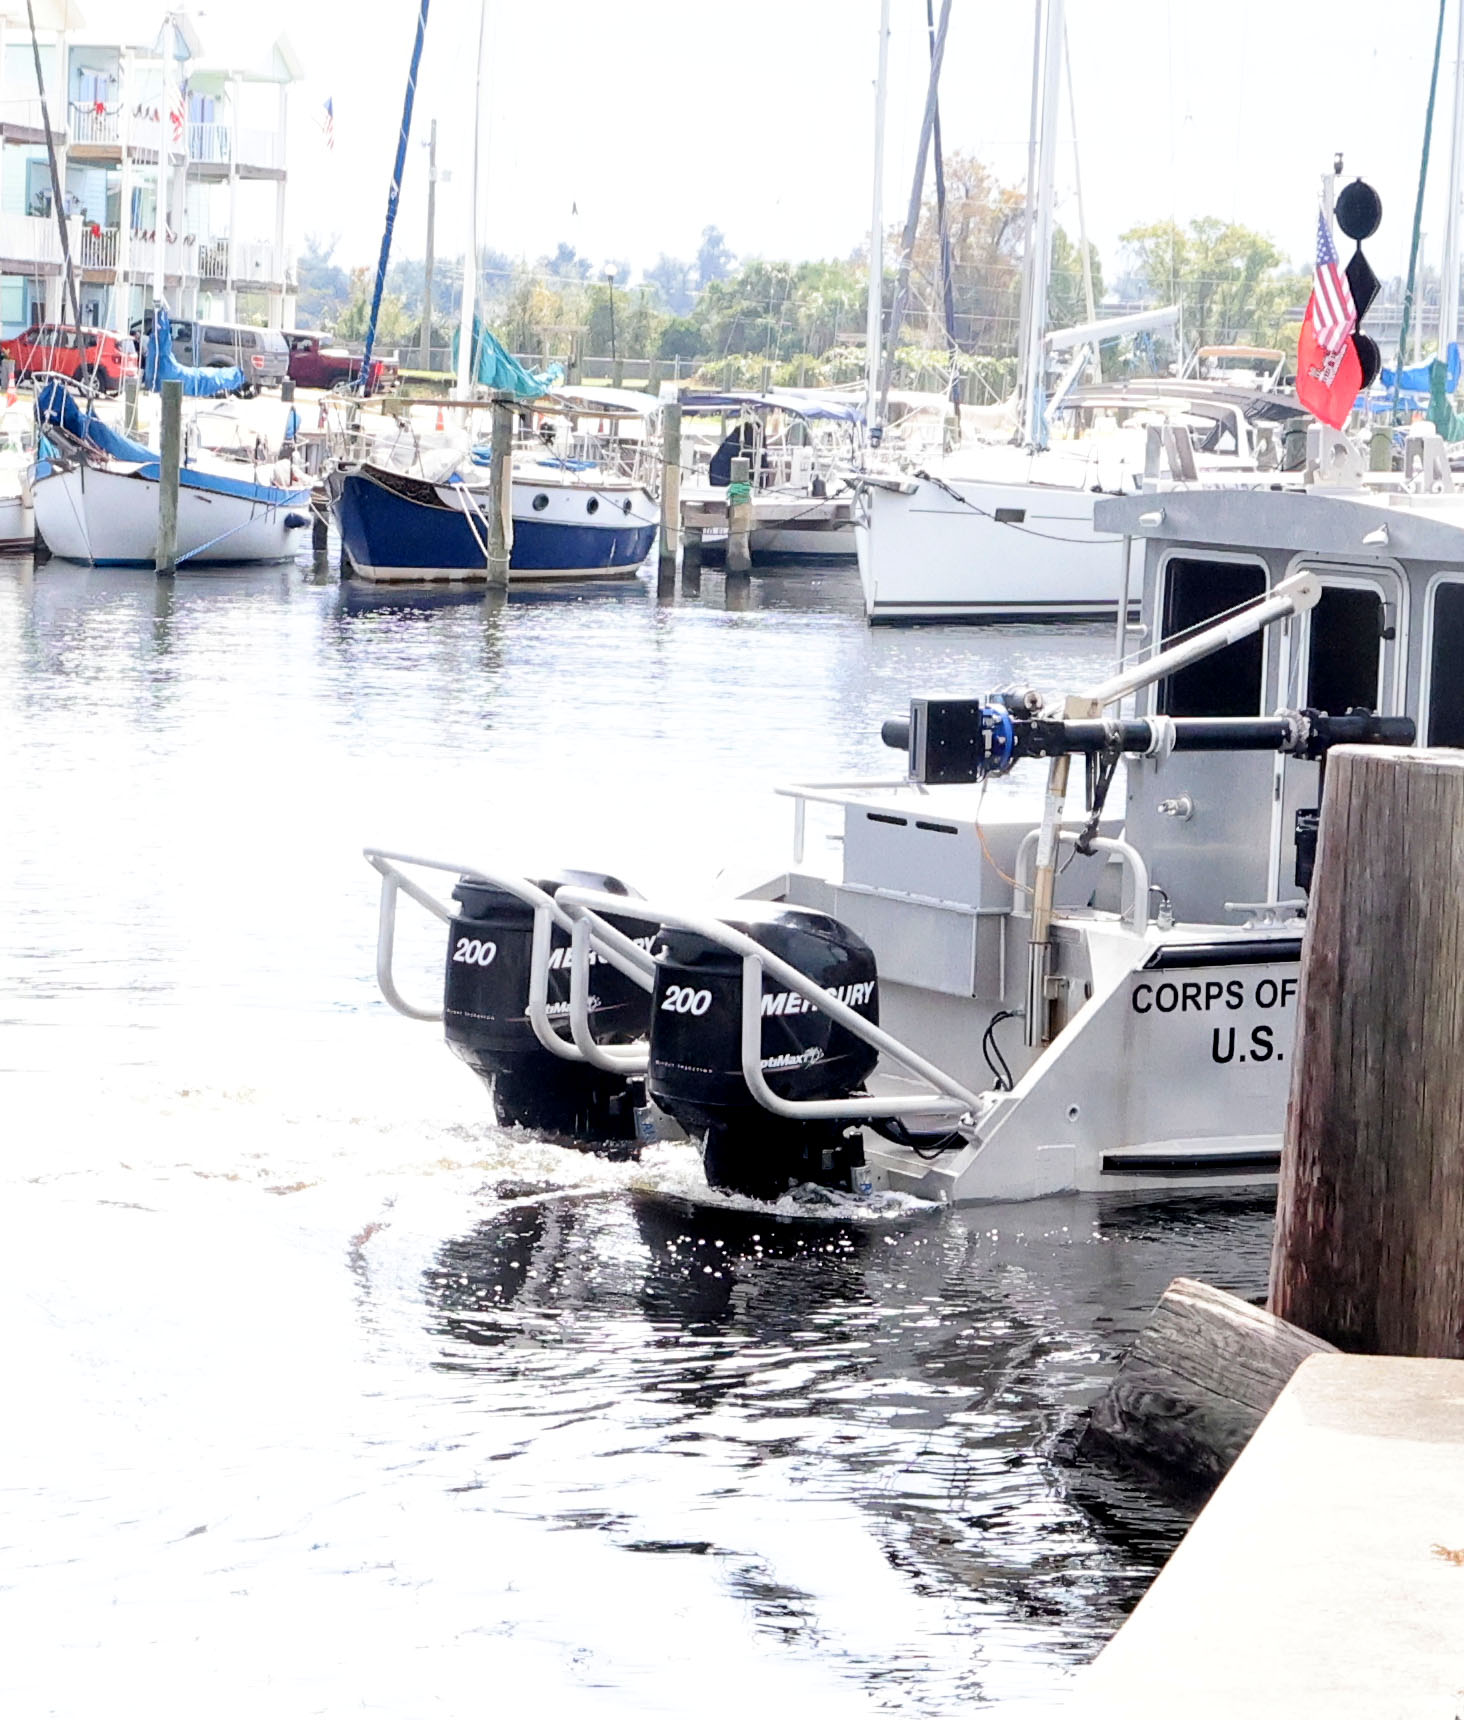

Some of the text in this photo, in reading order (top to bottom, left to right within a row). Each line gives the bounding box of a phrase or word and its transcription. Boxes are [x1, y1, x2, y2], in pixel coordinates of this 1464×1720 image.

[453, 937, 497, 967] 200
[661, 985, 712, 1016] 200
[1132, 978, 1298, 1013] CORPS OF
[1212, 1025, 1283, 1064] U.S.
